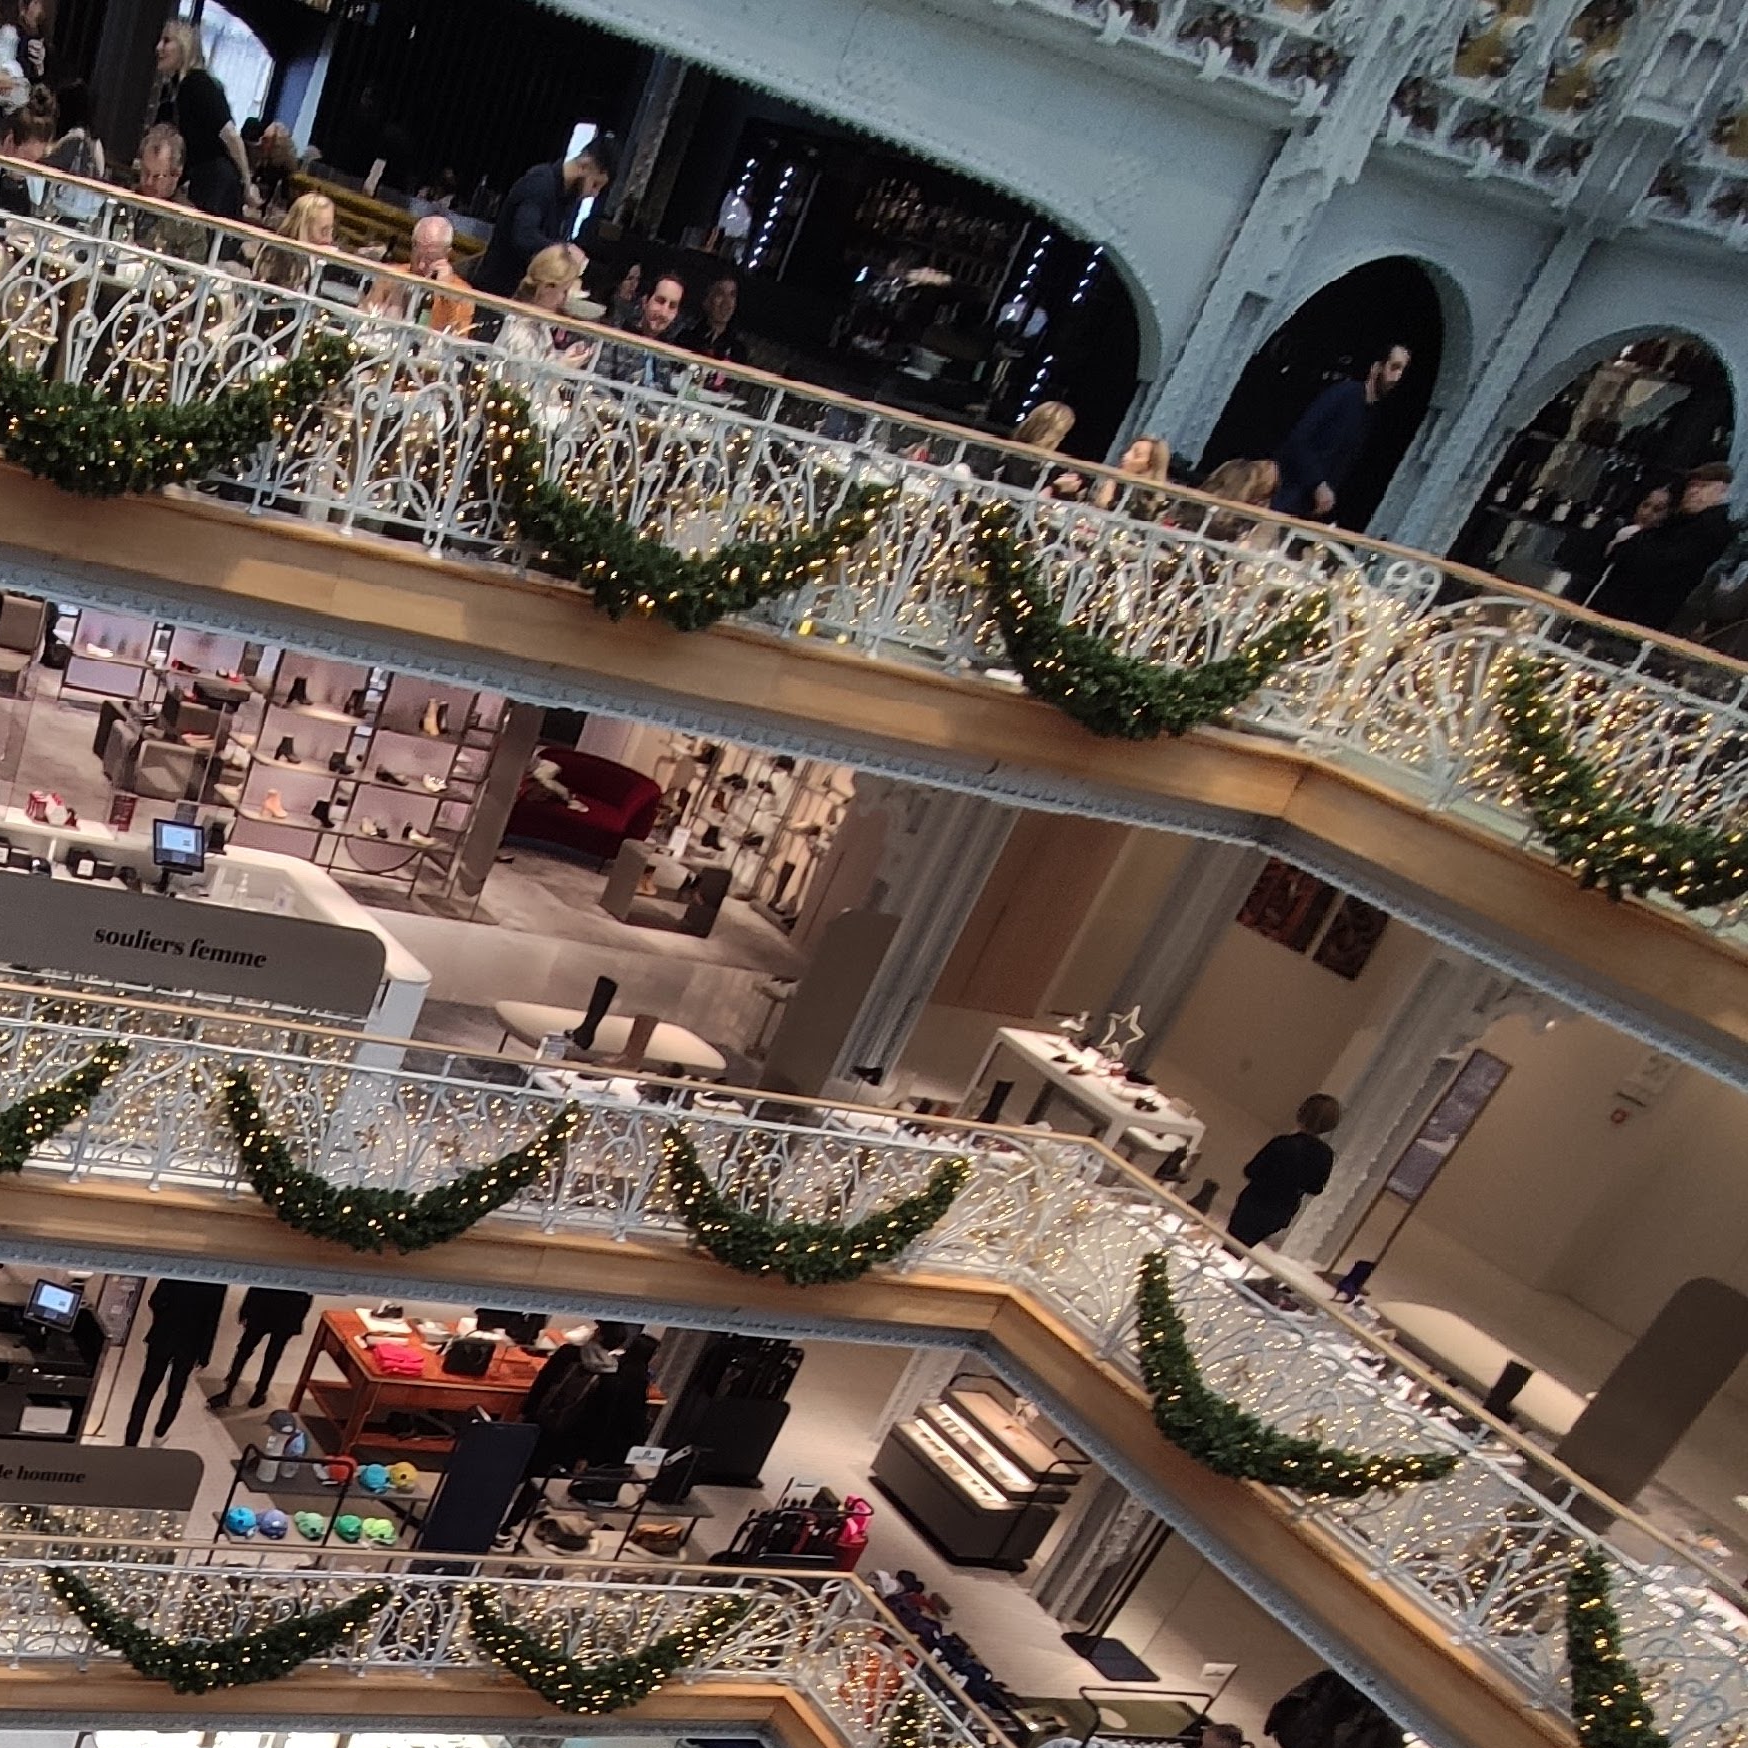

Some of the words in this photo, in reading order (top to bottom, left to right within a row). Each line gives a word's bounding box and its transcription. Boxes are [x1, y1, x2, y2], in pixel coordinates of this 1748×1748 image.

[93, 927, 186, 955] souliers
[189, 938, 268, 968] femme
[16, 1465, 86, 1483] homme
